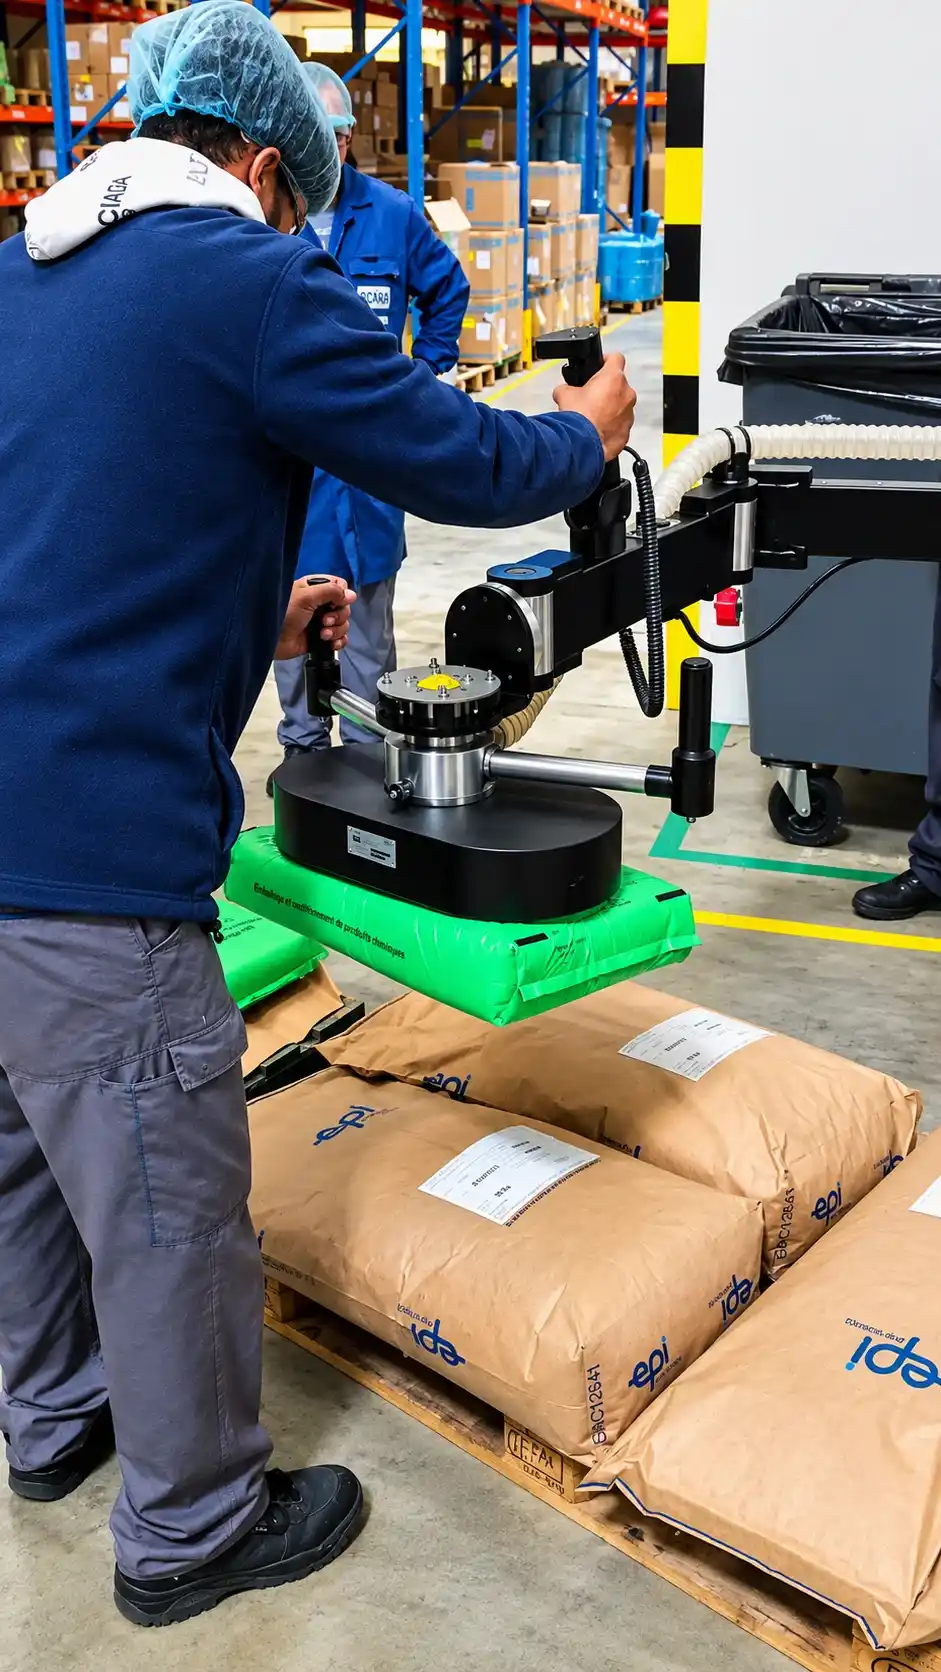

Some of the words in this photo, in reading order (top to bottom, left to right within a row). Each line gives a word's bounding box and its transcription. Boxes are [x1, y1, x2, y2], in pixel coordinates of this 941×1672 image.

[811, 1181, 842, 1226] epi
[628, 1335, 669, 1392] epi
[845, 1336, 941, 1389] epi
